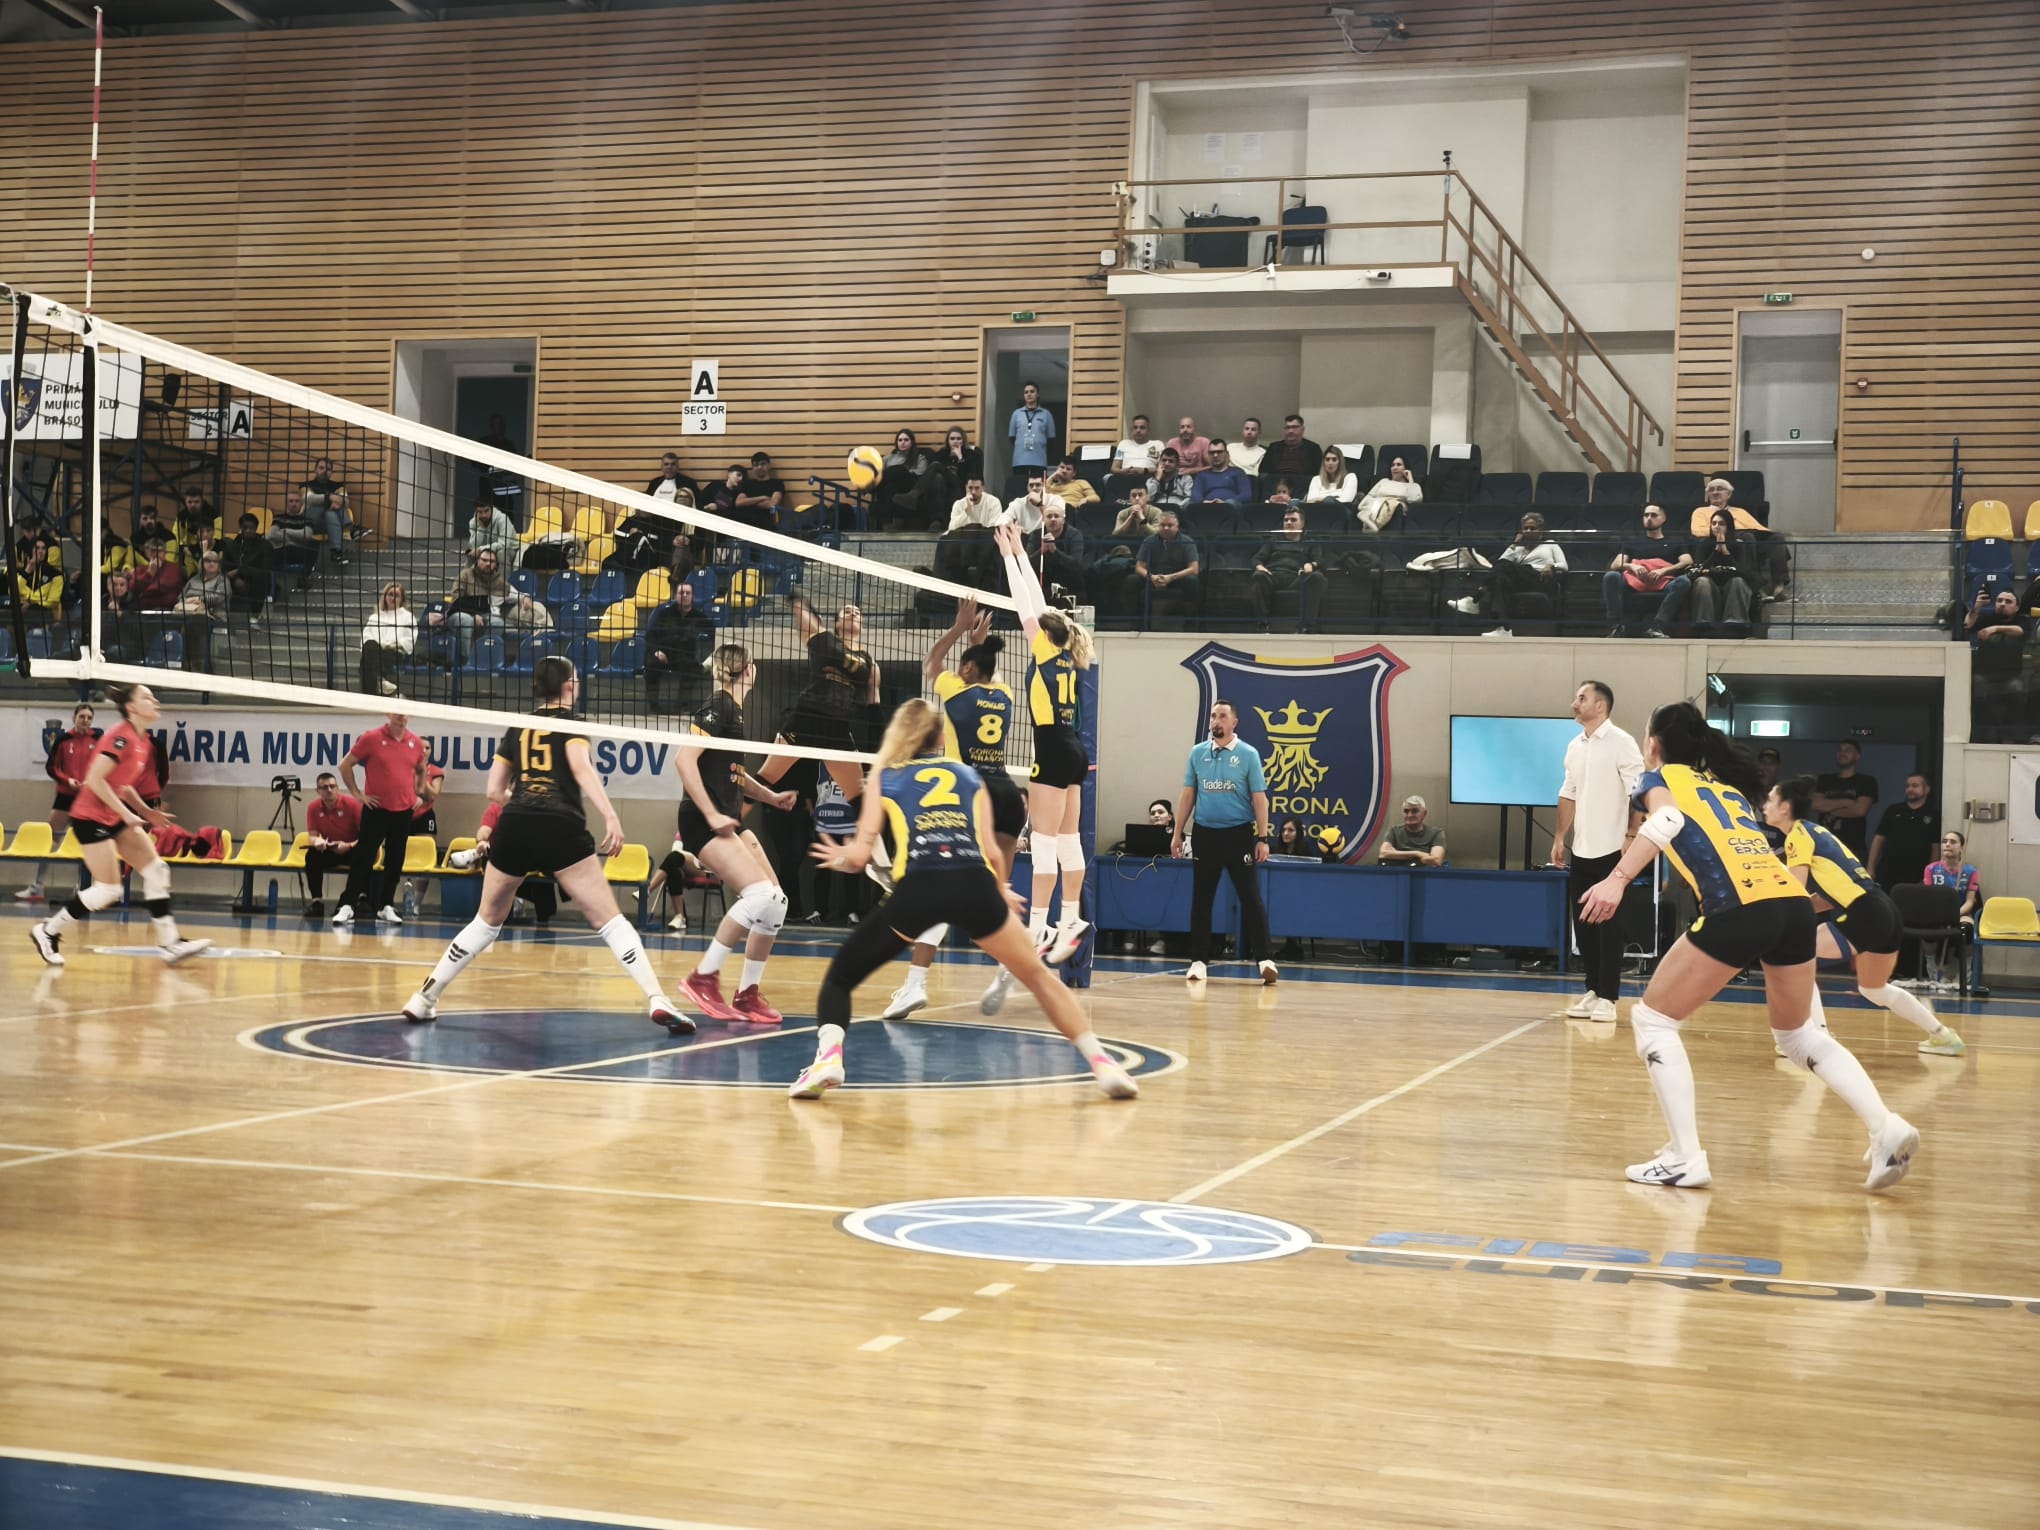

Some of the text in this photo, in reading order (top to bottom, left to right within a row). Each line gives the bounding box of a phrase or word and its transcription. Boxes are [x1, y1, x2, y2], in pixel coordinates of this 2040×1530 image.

[46, 382, 83, 394] PRIMĂ
[694, 371, 714, 395] A
[232, 410, 249, 433] A
[684, 406, 725, 414] SECTOR
[44, 416, 82, 428] BRAȘO
[700, 419, 707, 431] 3
[977, 714, 1003, 744] 8
[519, 728, 552, 771] 15
[914, 767, 961, 808] 2
[1696, 787, 1761, 832] 13
[1933, 875, 1944, 885] 13
